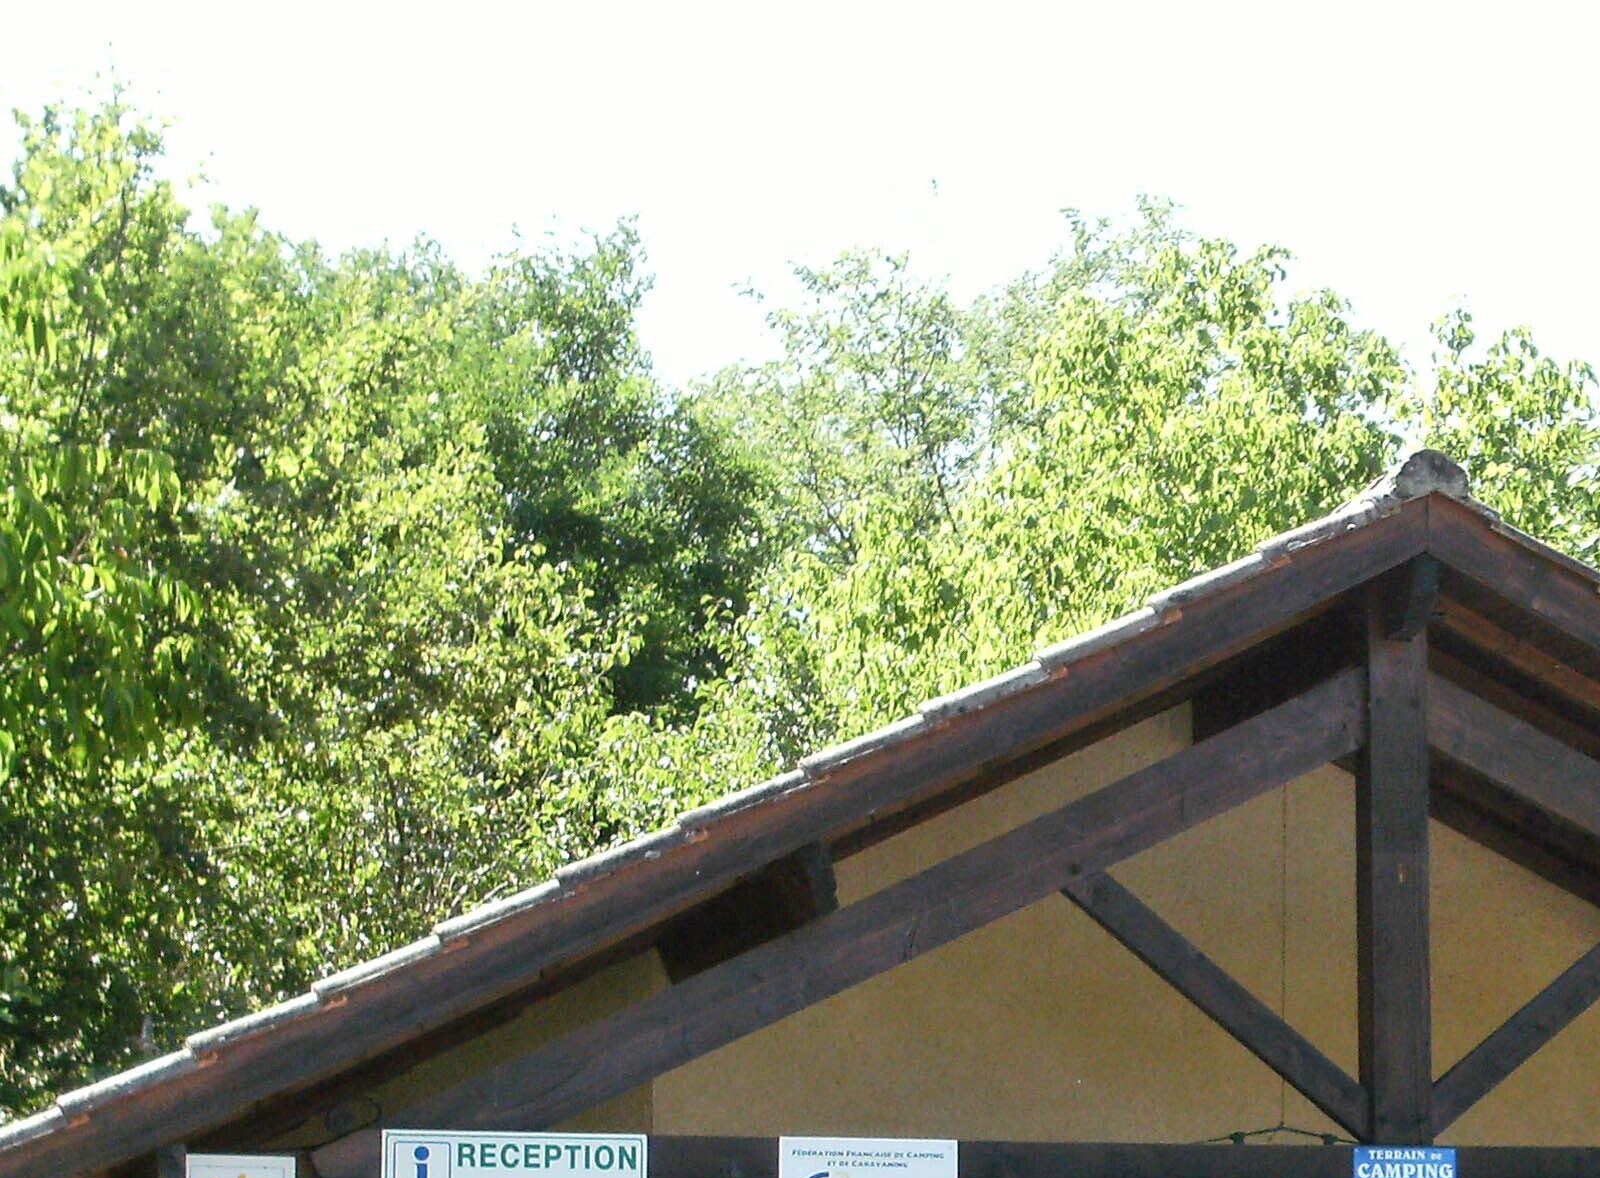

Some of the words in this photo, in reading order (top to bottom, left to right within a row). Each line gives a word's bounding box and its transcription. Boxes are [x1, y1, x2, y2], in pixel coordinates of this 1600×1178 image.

[456, 1142, 637, 1170] RECEPTION
[906, 1151, 945, 1160] CAMPING
[1368, 1149, 1426, 1161] TERRAIN
